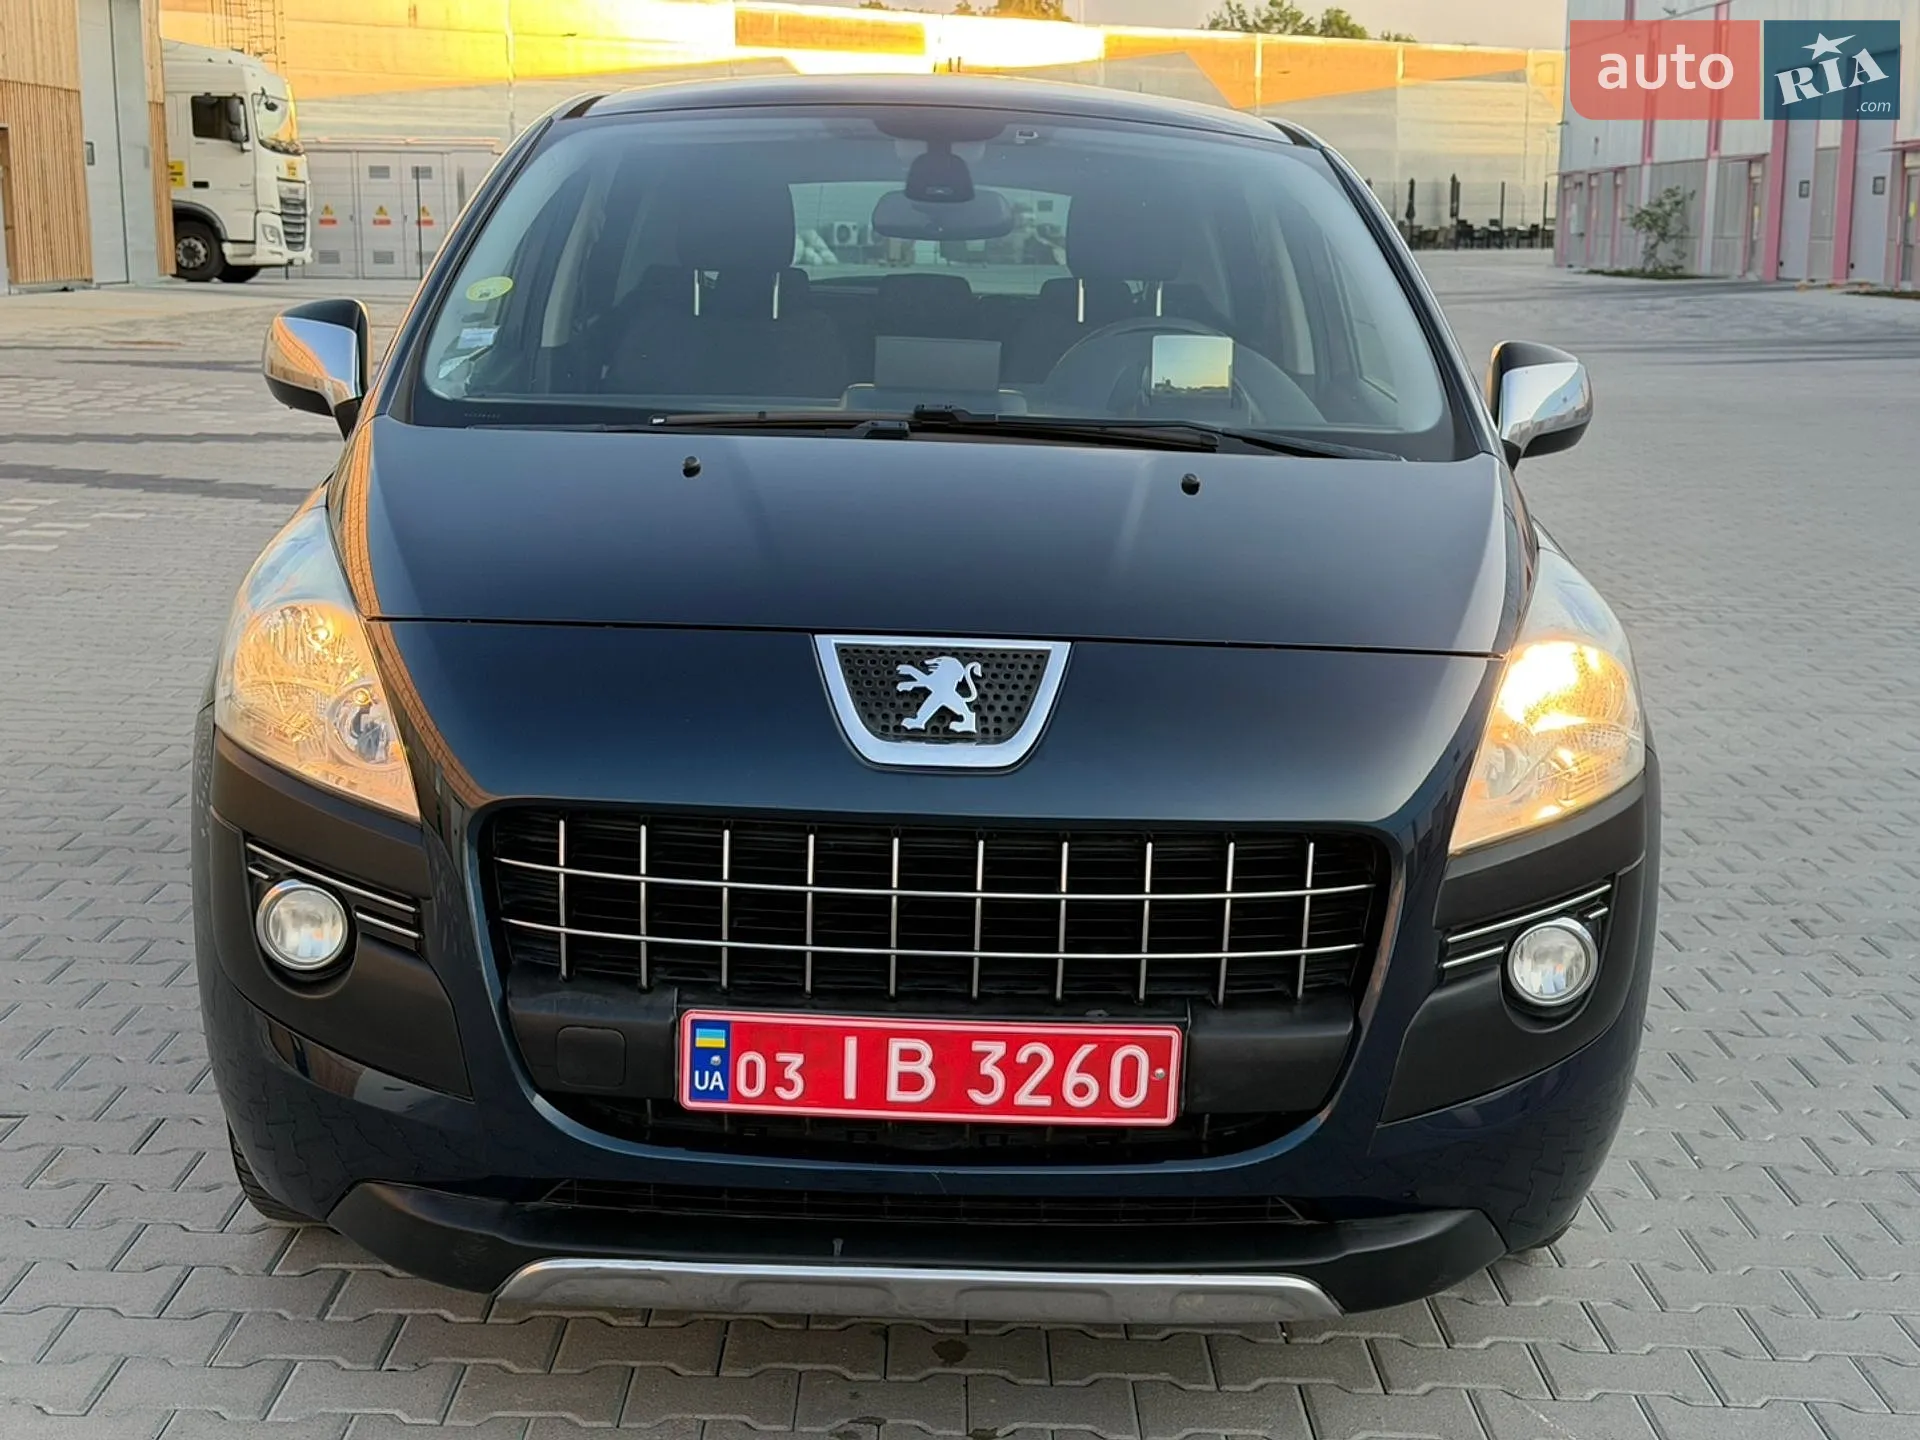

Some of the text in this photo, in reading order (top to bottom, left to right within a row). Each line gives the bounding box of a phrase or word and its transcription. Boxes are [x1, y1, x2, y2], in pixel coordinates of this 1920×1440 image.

[694, 1070, 725, 1092] UA
[736, 1051, 804, 1100] 03
[966, 1040, 1150, 1109] 3260
